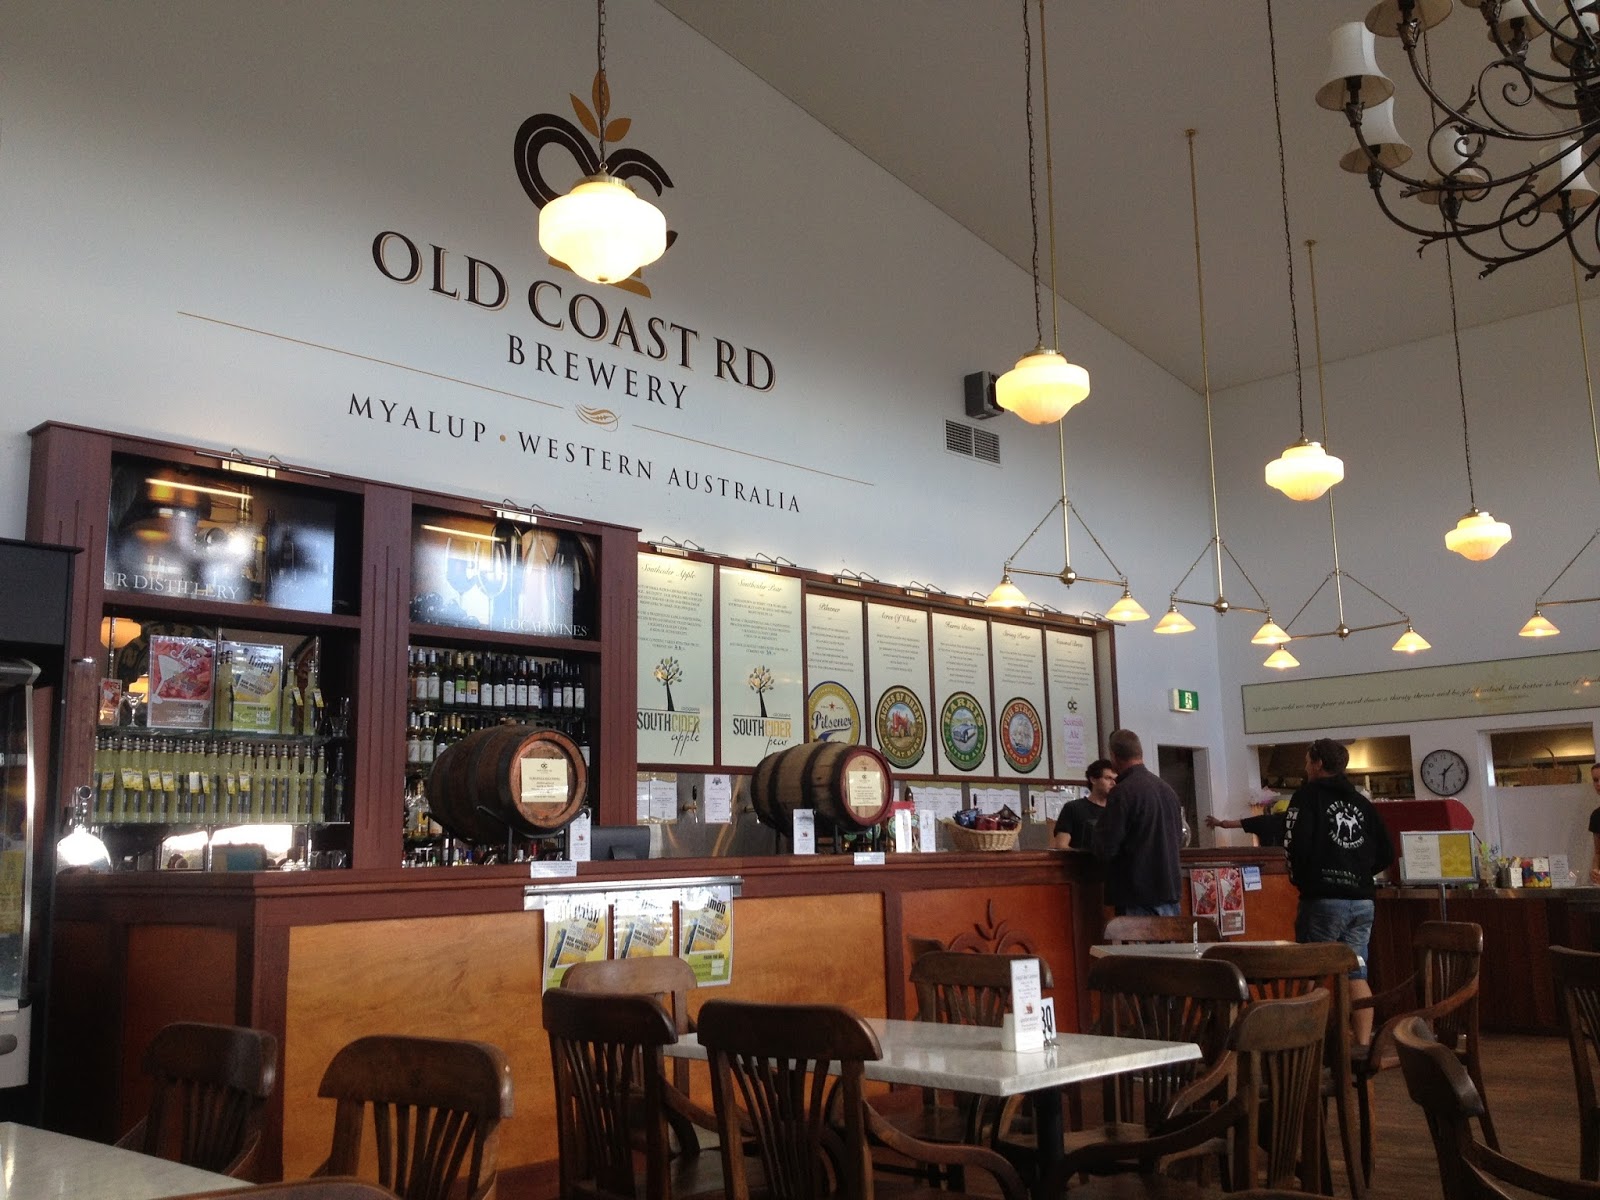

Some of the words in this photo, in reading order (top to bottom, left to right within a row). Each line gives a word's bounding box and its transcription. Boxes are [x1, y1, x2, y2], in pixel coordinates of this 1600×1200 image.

[371, 231, 509, 311] OLD
[527, 280, 699, 370] COAST
[714, 337, 776, 392] RD
[507, 334, 688, 410] BREWERY
[348, 392, 487, 443] MYALUP
[518, 430, 653, 480] WESTERN
[667, 468, 801, 513] AUSTRALIA
[676, 569, 696, 581] Apple
[503, 617, 546, 632] LOCAL
[547, 622, 588, 637] WINES
[880, 694, 896, 720] ACRES
[895, 692, 905, 702] OF
[905, 694, 922, 723] WHEAT
[1014, 704, 1038, 731] STRONG
[637, 712, 700, 734] SOUTHCIDER
[733, 718, 792, 738] SOUTHCIDER
[811, 711, 854, 731] Pilsener
[670, 719, 700, 756] apple
[764, 736, 789, 758] pear
[883, 736, 905, 758] WHEAT
[907, 737, 922, 757] BEER
[947, 740, 970, 761] BITTER
[971, 742, 982, 757] ALE
[1006, 743, 1028, 763] PORTER
[1029, 746, 1038, 760] ALE
